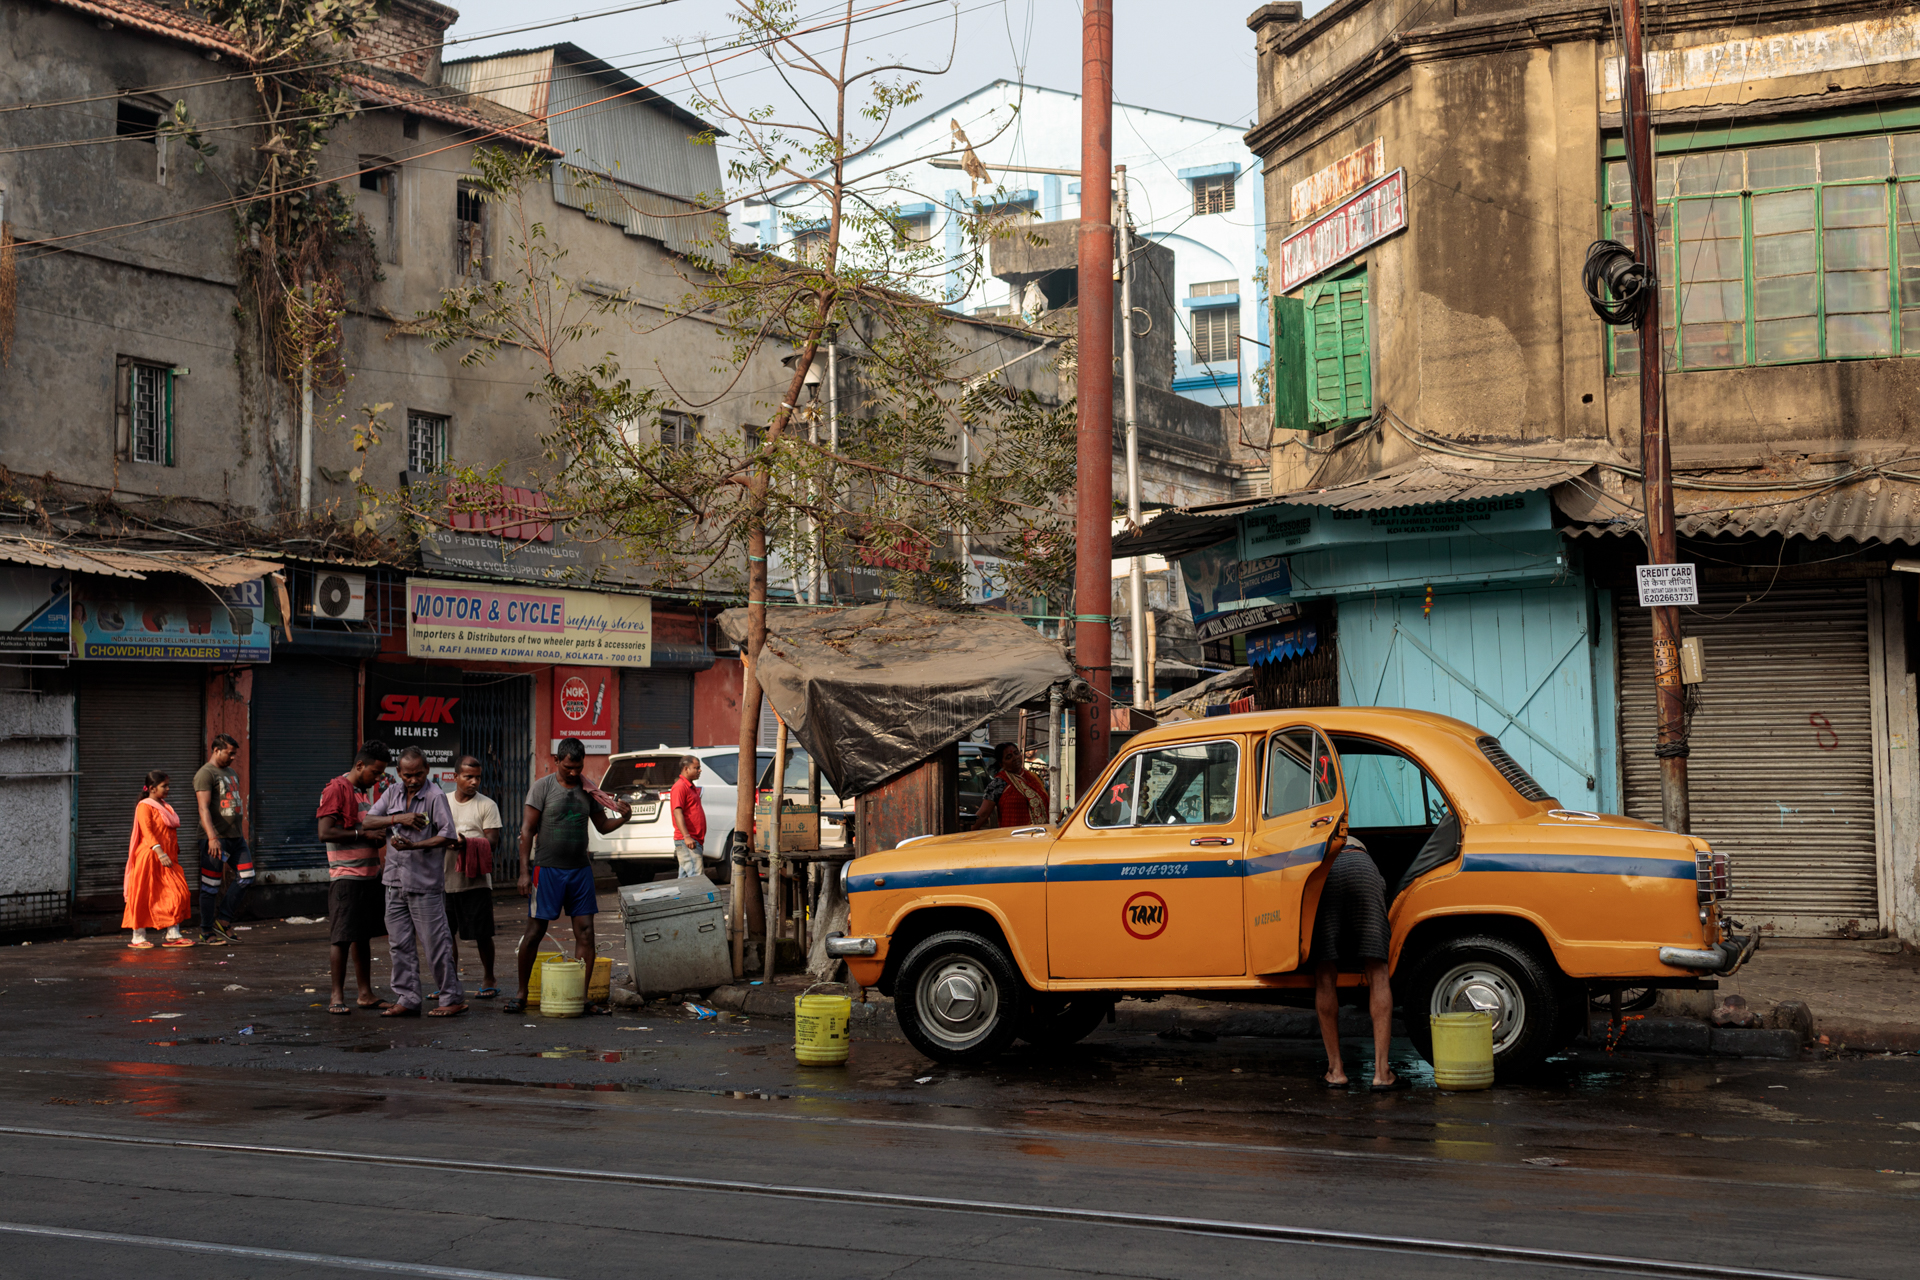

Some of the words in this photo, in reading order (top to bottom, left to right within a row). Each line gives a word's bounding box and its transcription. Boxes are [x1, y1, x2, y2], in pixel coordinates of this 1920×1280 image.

[1348, 178, 1401, 249] CENTRE
[1333, 510, 1362, 520] DEB
[1368, 507, 1410, 518] AUTO
[1412, 498, 1525, 516] ACCESSORIES
[1467, 513, 1491, 521] ROAD
[1247, 517, 1260, 528] DEB
[1267, 517, 1311, 534] ACCESSORIES
[455, 535, 517, 553] PROTECTION
[519, 545, 580, 559] TECHNOLOGY
[483, 562, 508, 573] CYCLE
[511, 564, 539, 576] SUPPLY
[1260, 570, 1281, 584] CABLES
[1641, 568, 1669, 578] CREDIT
[1671, 567, 1692, 577] CARD
[1644, 593, 1694, 603] 6202663737
[415, 594, 482, 621] MOTOR
[488, 599, 501, 622] &
[507, 601, 562, 625] CYCLE
[566, 614, 608, 634] supply
[611, 616, 645, 631] stores
[1206, 619, 1227, 637] KOUL
[1223, 613, 1243, 631] AUTO
[1240, 607, 1268, 626] CENTRE
[413, 628, 455, 640] Importers
[458, 630, 464, 640] &
[467, 631, 515, 643] Distributors
[517, 635, 526, 643] of
[527, 635, 542, 645] two
[543, 636, 574, 646] wheeler
[575, 639, 595, 649] parts
[597, 638, 603, 648] &
[604, 641, 646, 650] accessories
[90, 646, 164, 657] CHOWDHURI
[167, 647, 221, 658] TRADERS
[438, 645, 461, 653] RAFI
[464, 647, 498, 655] AHMED
[500, 648, 534, 657] KIDWAI
[536, 650, 563, 659] ROAD,
[565, 652, 604, 660] KOLKATA
[611, 653, 626, 661] 700
[627, 654, 643, 662] 013
[565, 687, 585, 698] NGK
[376, 694, 460, 724] SMK
[394, 726, 439, 738] HELMETS
[1129, 905, 1163, 926] TAXI
